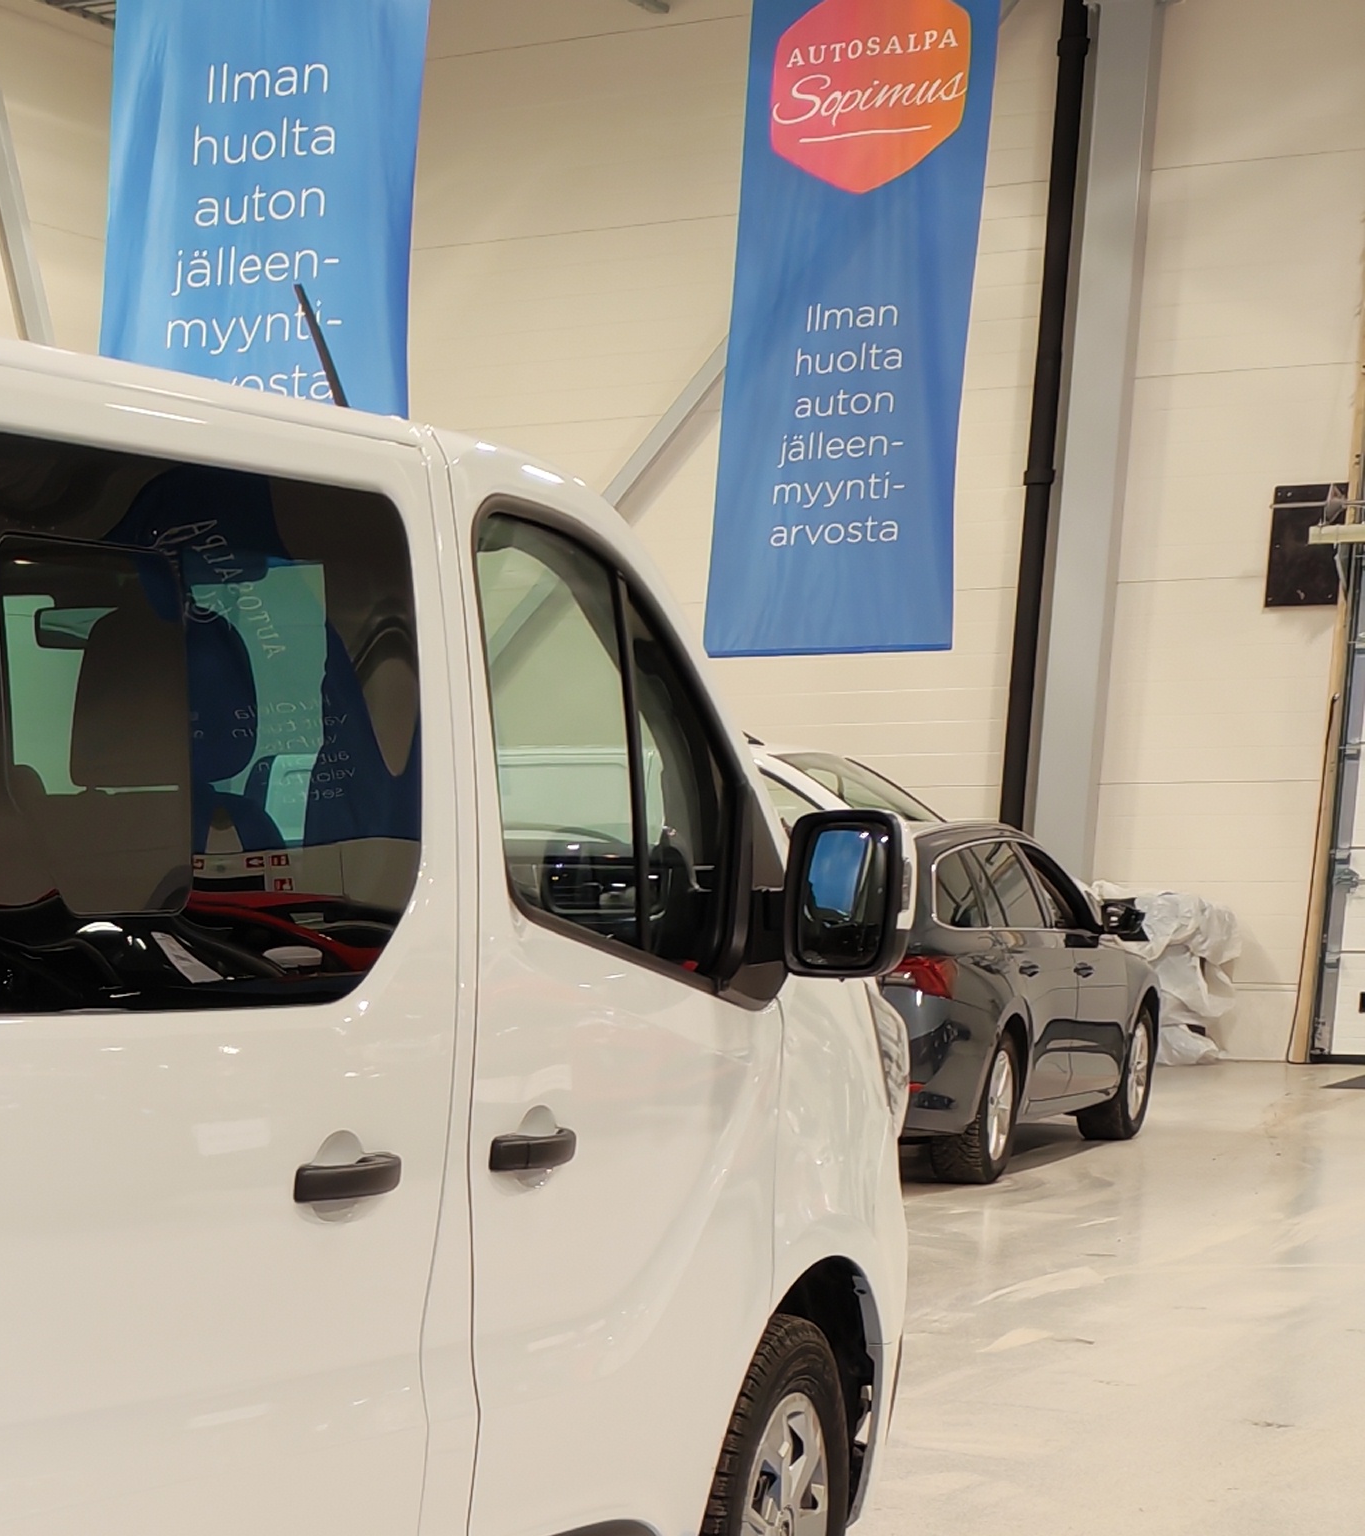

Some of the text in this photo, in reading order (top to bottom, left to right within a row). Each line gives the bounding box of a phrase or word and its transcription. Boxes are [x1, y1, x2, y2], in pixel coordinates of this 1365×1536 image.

[785, 28, 959, 69] AUTOSALPA
[207, 62, 330, 104] Ilman
[771, 70, 968, 127] Sopimus
[192, 116, 336, 166] huolta
[194, 184, 326, 228] auton
[171, 246, 340, 297] jälleen-
[805, 302, 899, 333] Ilman
[795, 341, 904, 377] huolta
[794, 389, 895, 419] auton
[777, 430, 905, 469] jälleen-
[772, 471, 906, 509] myynti-
[770, 515, 900, 548] arvosta
